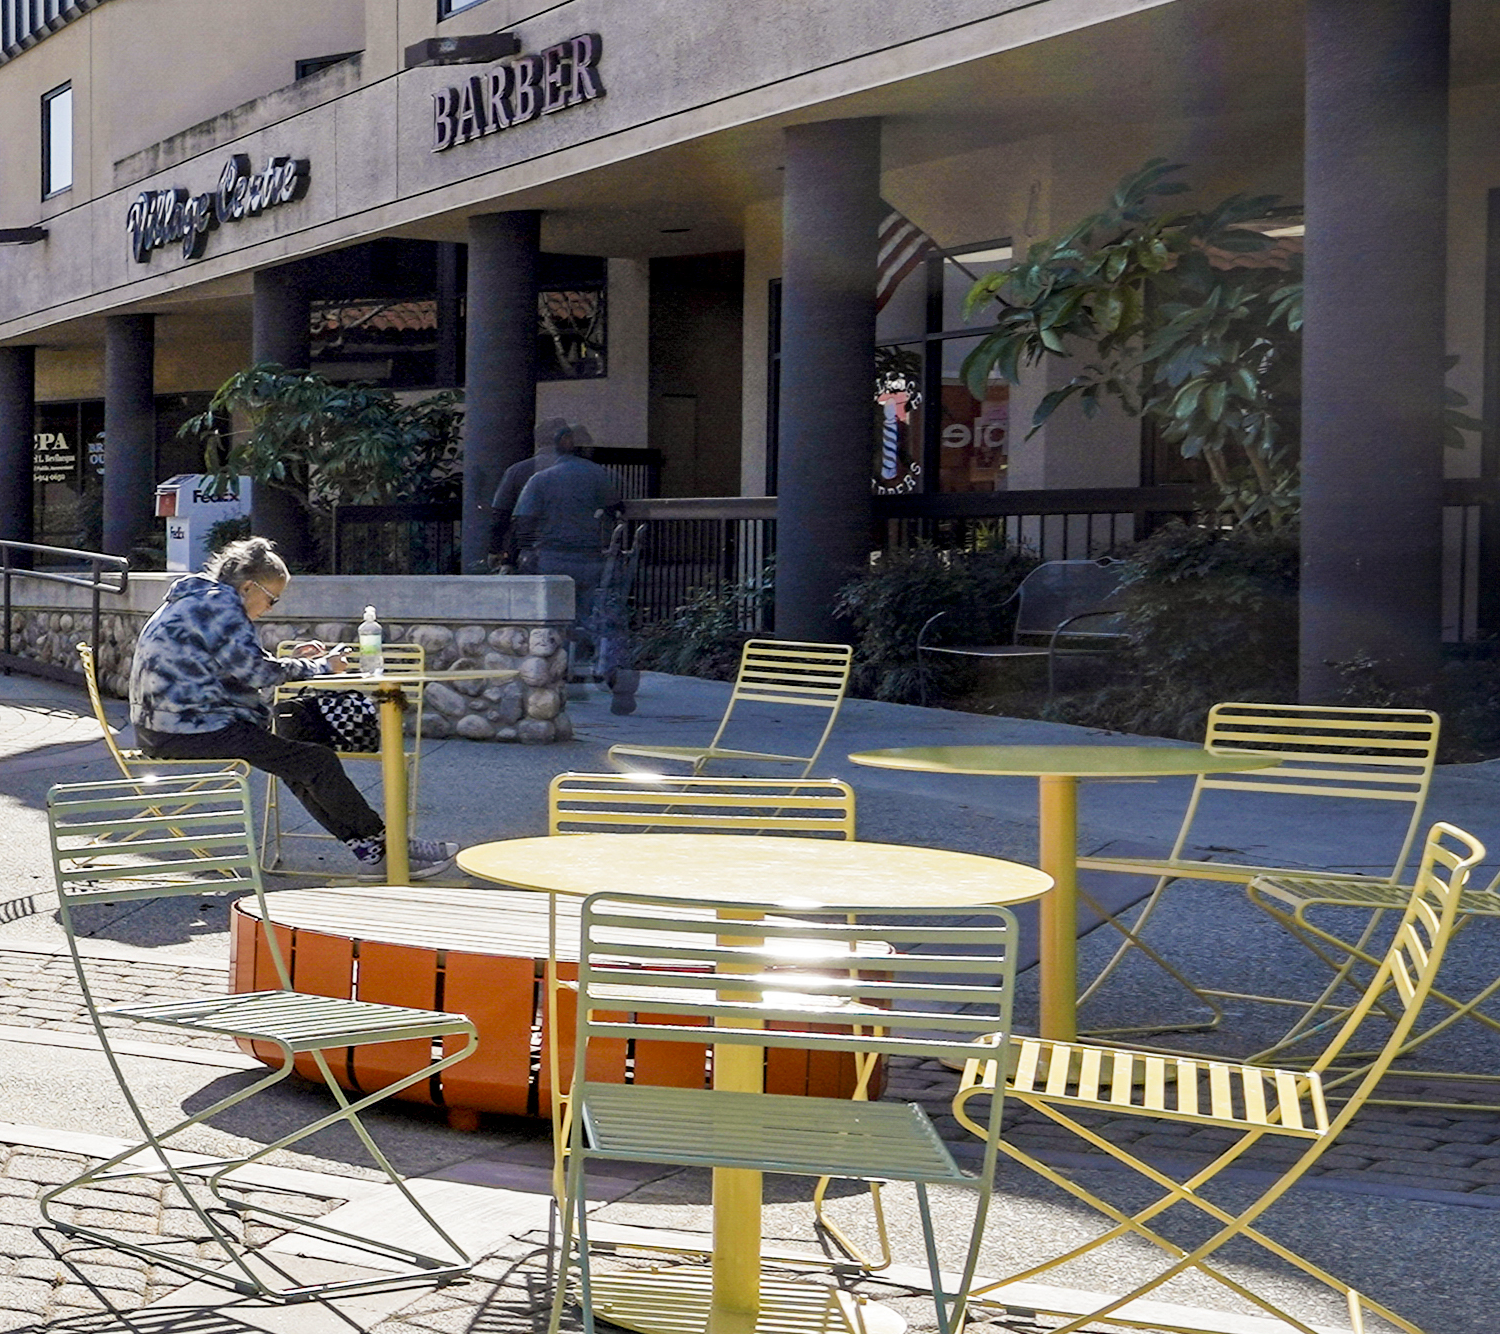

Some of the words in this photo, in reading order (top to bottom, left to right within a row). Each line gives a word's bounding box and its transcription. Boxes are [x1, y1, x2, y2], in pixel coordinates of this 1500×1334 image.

[431, 34, 598, 153] BARBER
[127, 190, 212, 263] Village
[214, 155, 302, 224] Centre
